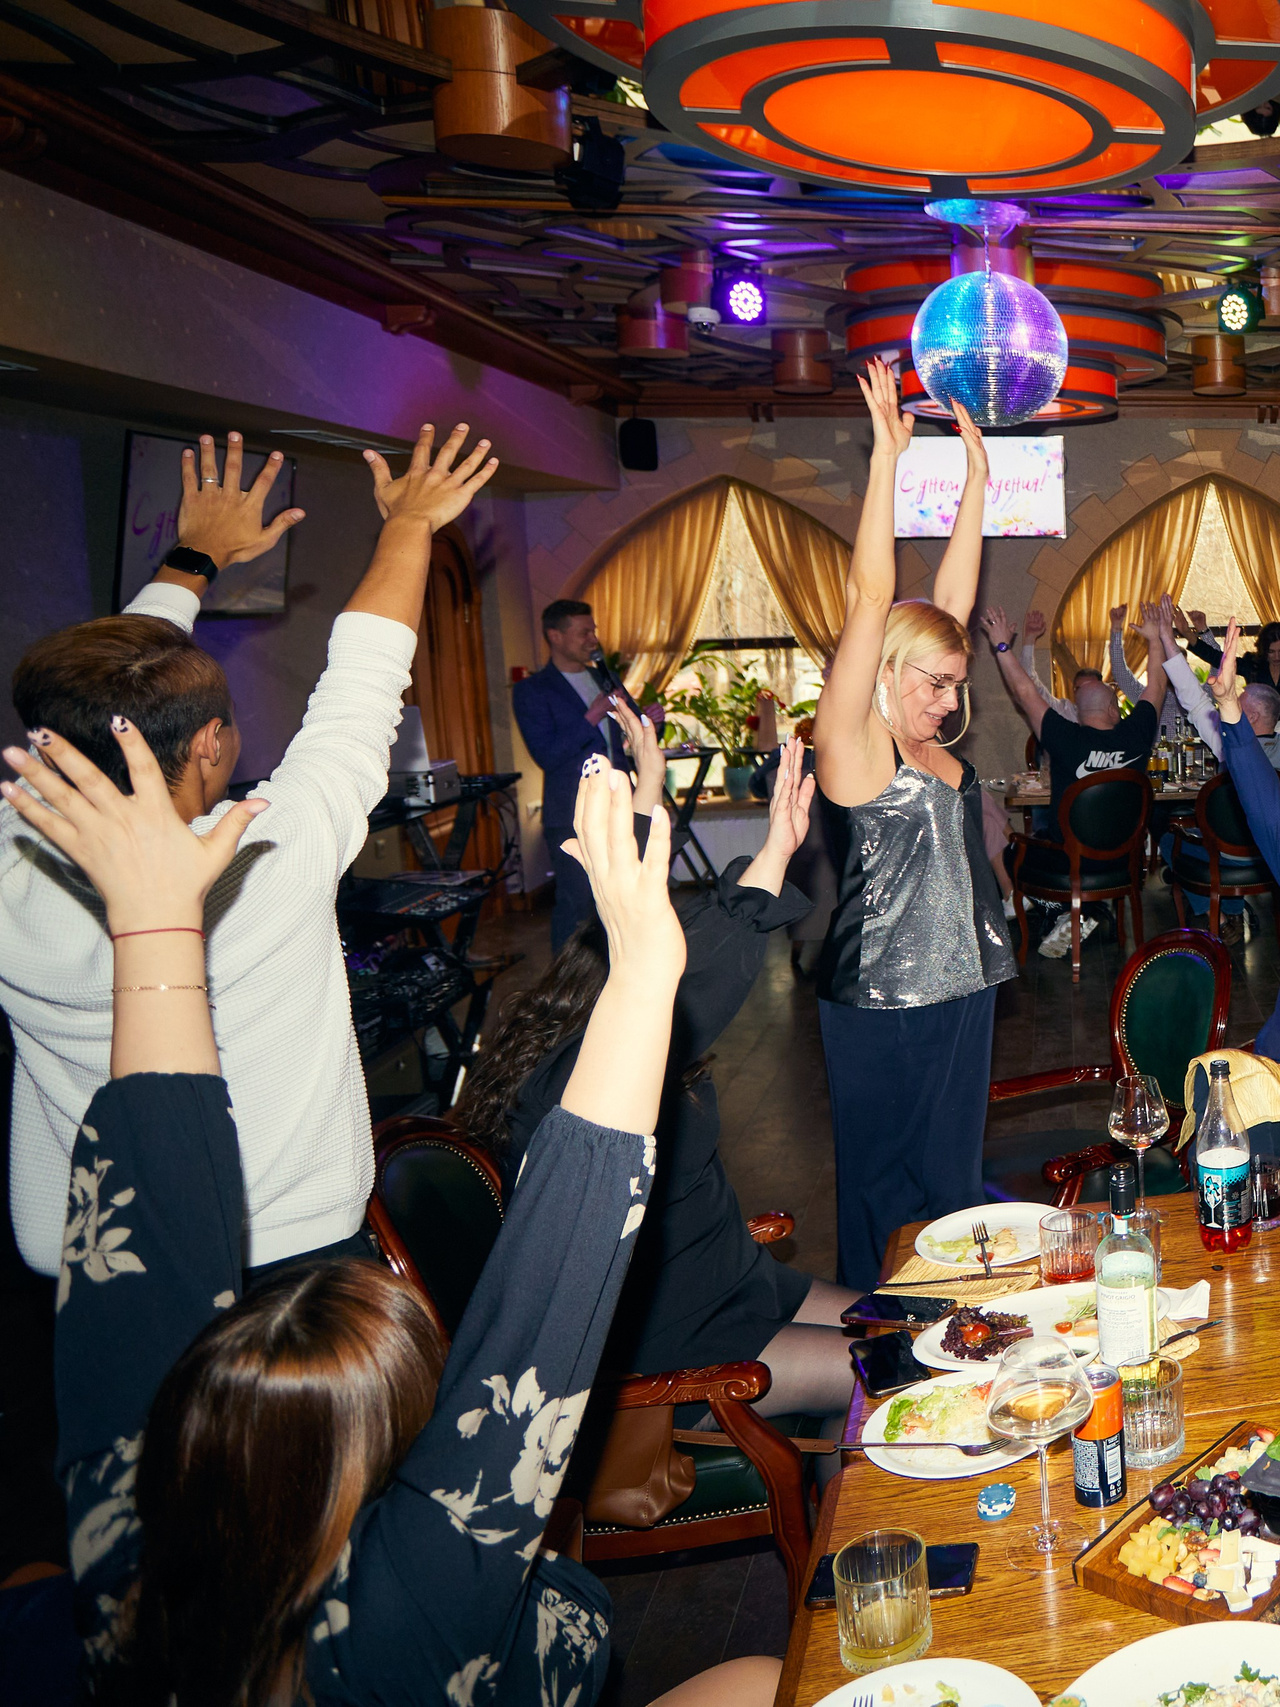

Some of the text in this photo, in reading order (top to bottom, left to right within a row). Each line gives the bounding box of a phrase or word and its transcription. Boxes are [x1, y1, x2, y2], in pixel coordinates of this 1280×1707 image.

[900, 469, 915, 493] С
[916, 475, 959, 505] днем
[1086, 750, 1126, 768] NIKE
